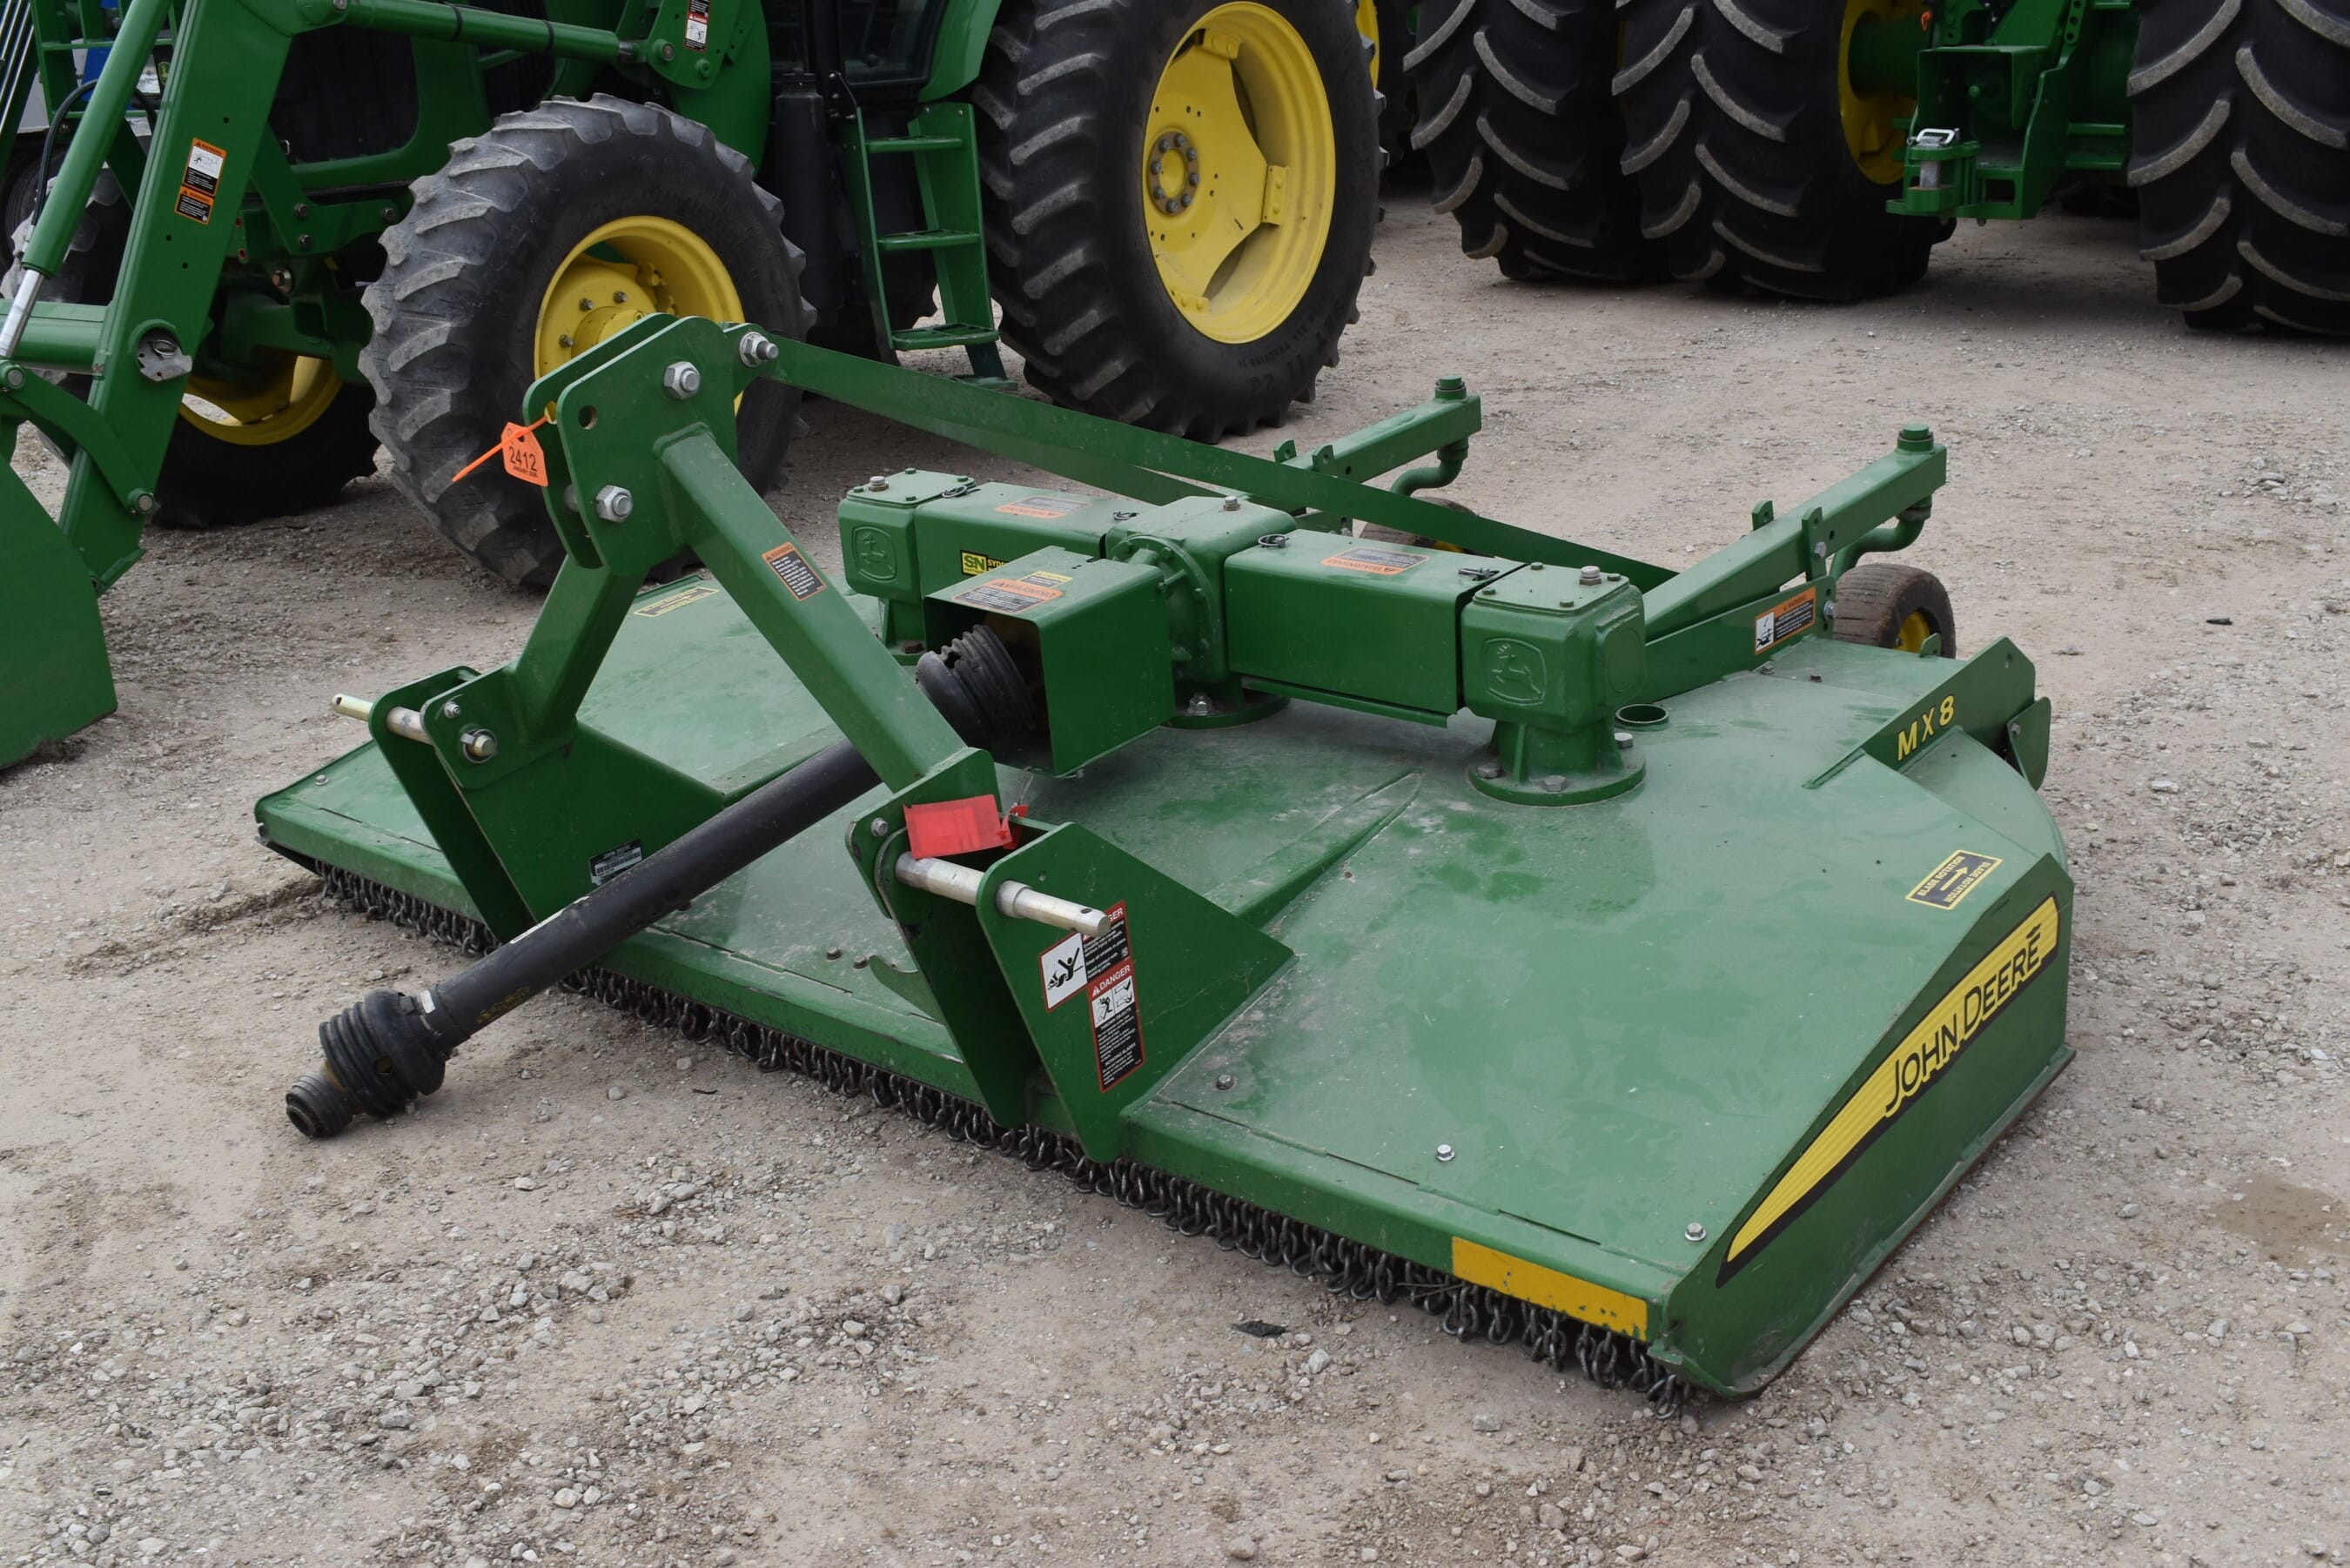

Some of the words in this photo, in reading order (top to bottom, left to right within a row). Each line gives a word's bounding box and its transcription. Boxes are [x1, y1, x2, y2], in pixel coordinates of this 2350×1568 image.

[508, 446, 537, 472] 2412
[1917, 878, 1940, 896] BLADE
[1935, 855, 1966, 880] ROTATION
[1943, 876, 1974, 903] ROTATION
[1099, 965, 1131, 990] DANGER
[1885, 1012, 1957, 1114] JOHN
[1964, 931, 2043, 1035] DEERE
